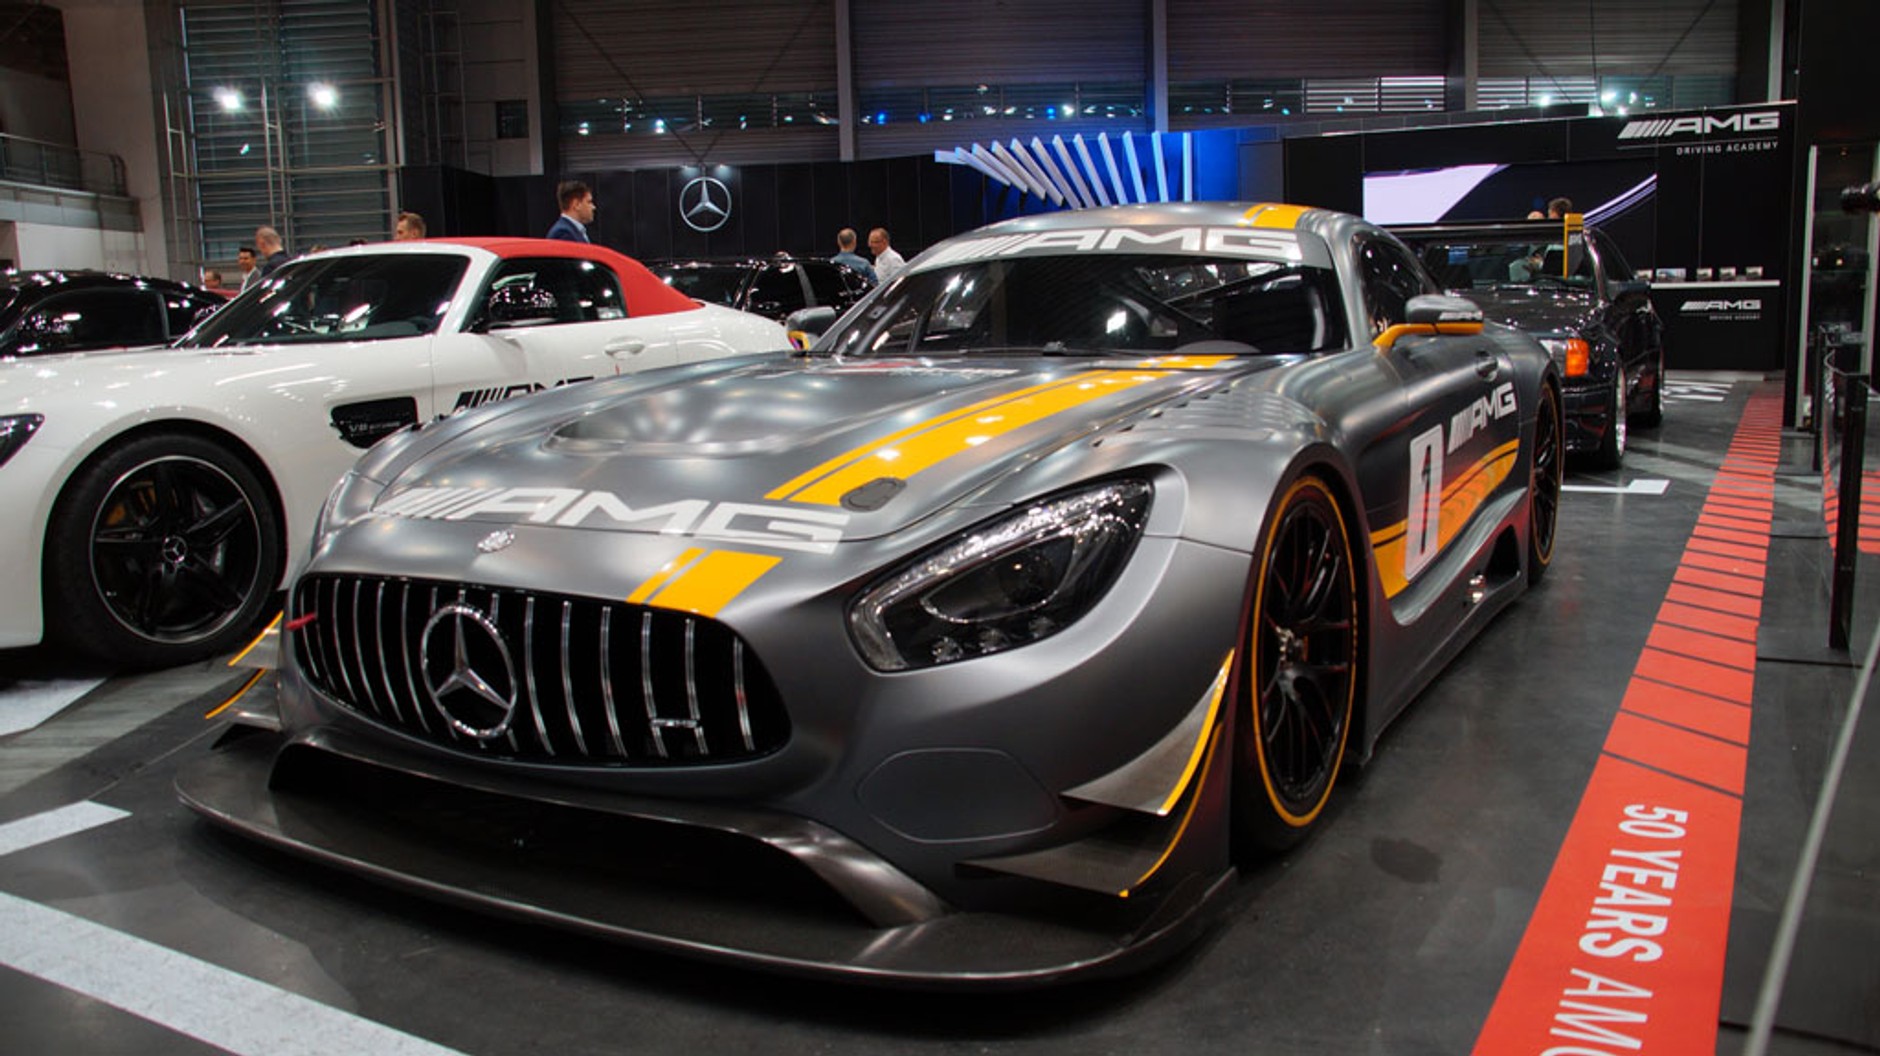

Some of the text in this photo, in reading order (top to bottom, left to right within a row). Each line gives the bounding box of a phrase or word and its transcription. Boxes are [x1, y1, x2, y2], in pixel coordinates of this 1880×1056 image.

[1665, 111, 1780, 137] AMG
[1676, 141, 1779, 156] DRIVING ACADEMY
[1009, 227, 1302, 260] AMG
[1470, 382, 1518, 436] AMG
[446, 487, 850, 555] AMG
[1540, 804, 1688, 1056] 50 YEARS AM
